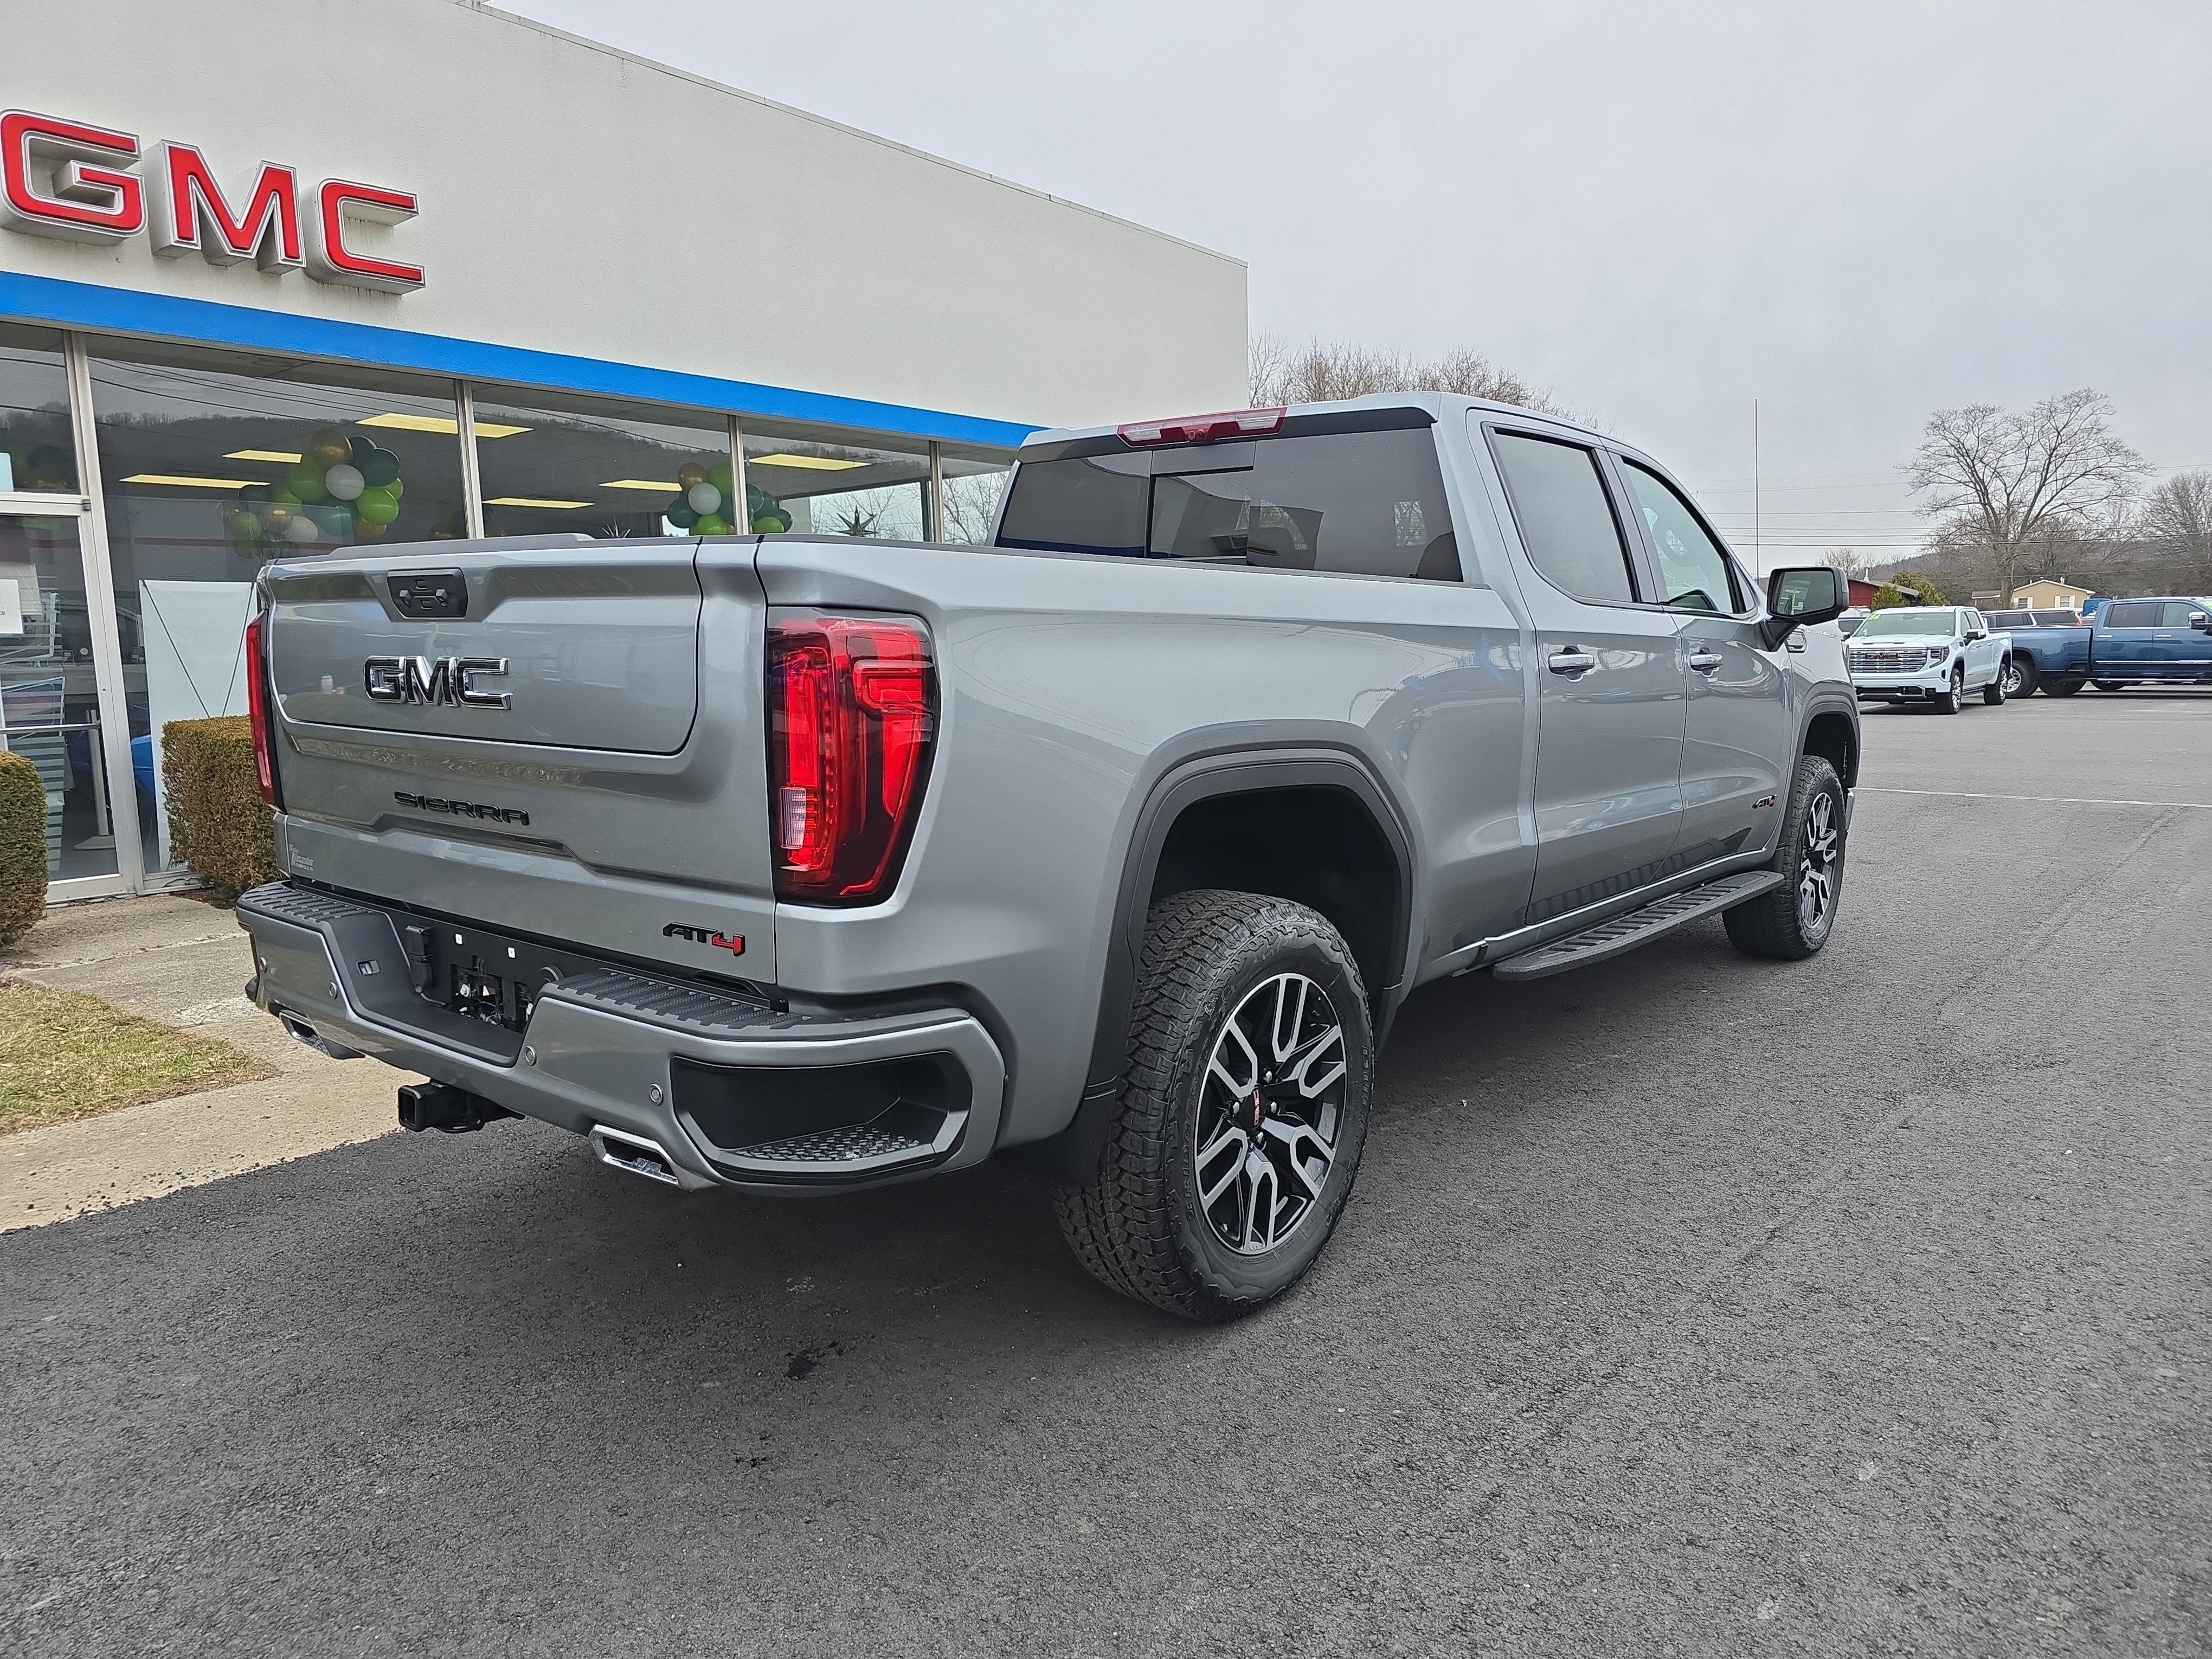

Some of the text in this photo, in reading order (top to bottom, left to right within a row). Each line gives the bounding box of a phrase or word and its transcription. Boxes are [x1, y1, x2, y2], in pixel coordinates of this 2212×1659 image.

[0, 108, 426, 295] GMC
[363, 655, 513, 710] GMC
[394, 790, 530, 826] SIERRA
[663, 921, 745, 957] AT4
